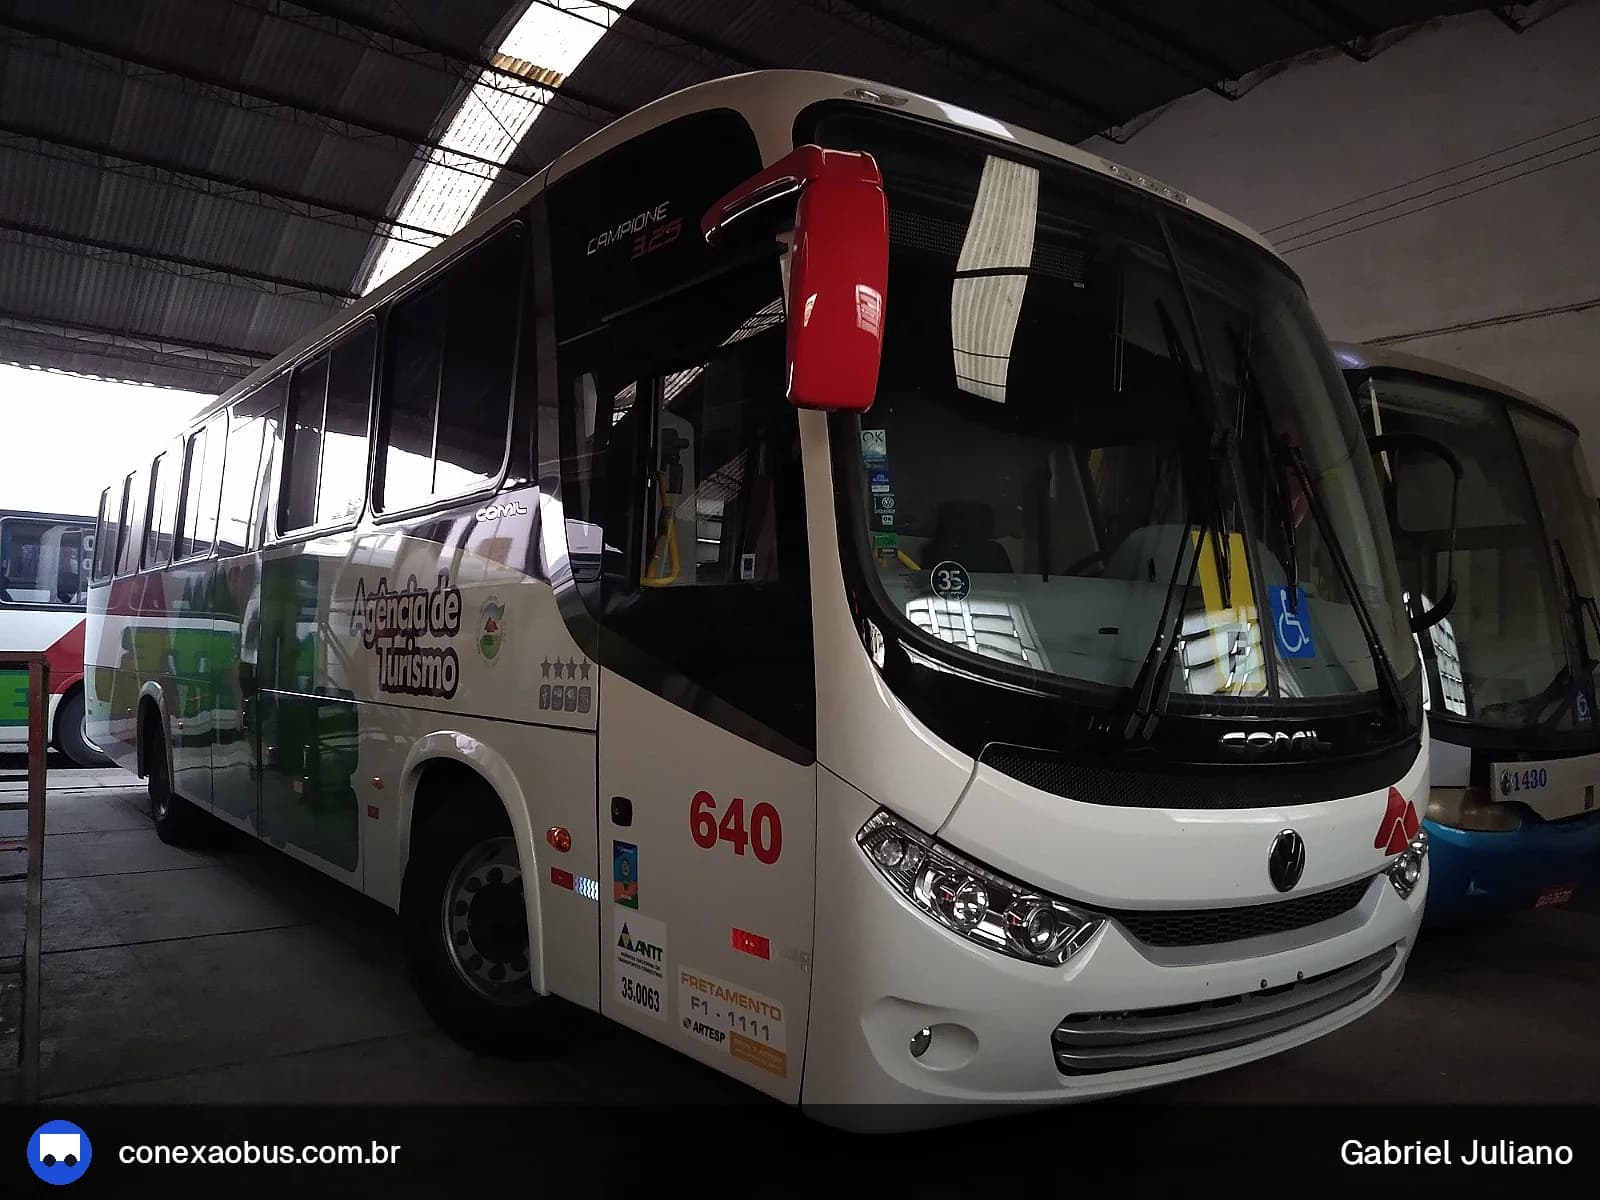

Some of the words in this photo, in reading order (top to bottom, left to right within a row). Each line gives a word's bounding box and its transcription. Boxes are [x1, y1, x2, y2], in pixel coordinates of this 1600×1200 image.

[586, 200, 670, 256] CAMPIONE
[862, 431, 884, 443] OK
[475, 501, 528, 522] COMIL
[937, 569, 962, 592] 35
[350, 575, 428, 648] Agência
[430, 569, 461, 637] de
[376, 636, 459, 698] Turismo
[690, 791, 782, 864] 640
[635, 940, 663, 962] ANTT
[621, 976, 660, 1012] 35.0063
[681, 972, 782, 1021] FRETAMENTO
[692, 1021, 726, 1044] ARTESP
[728, 1010, 770, 1041] 1111
